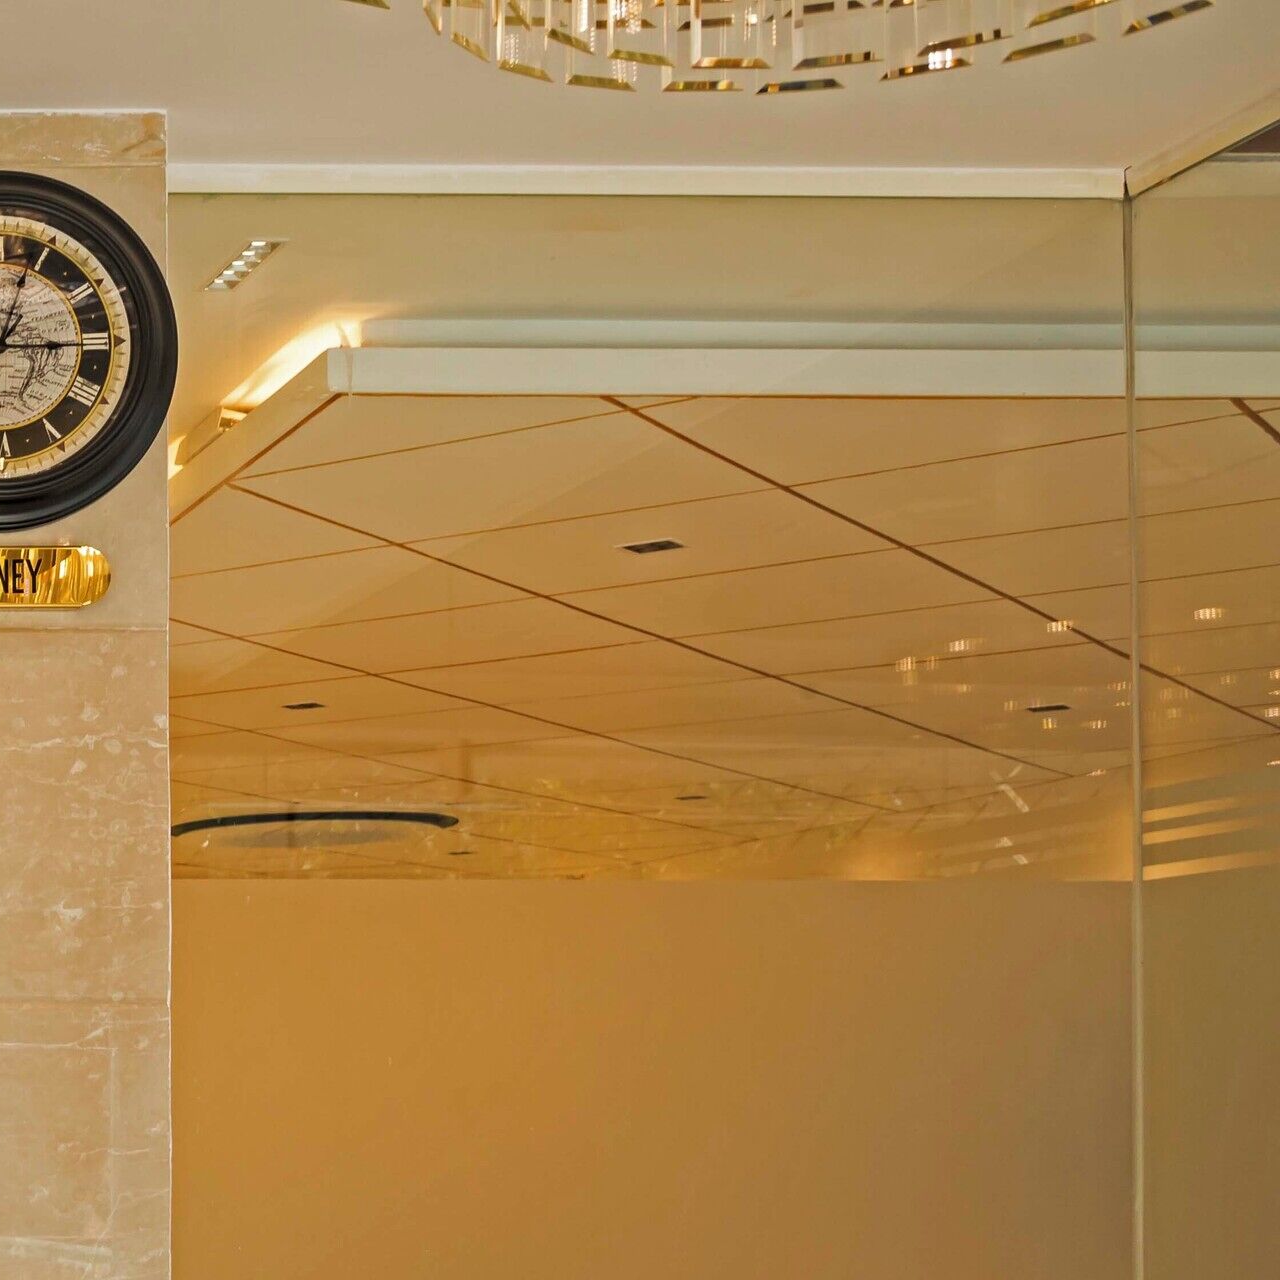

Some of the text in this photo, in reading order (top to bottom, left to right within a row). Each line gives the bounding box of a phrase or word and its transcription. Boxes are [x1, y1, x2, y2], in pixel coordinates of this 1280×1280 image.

[34, 247, 50, 271] I
[68, 283, 94, 304] II
[82, 333, 108, 350] III
